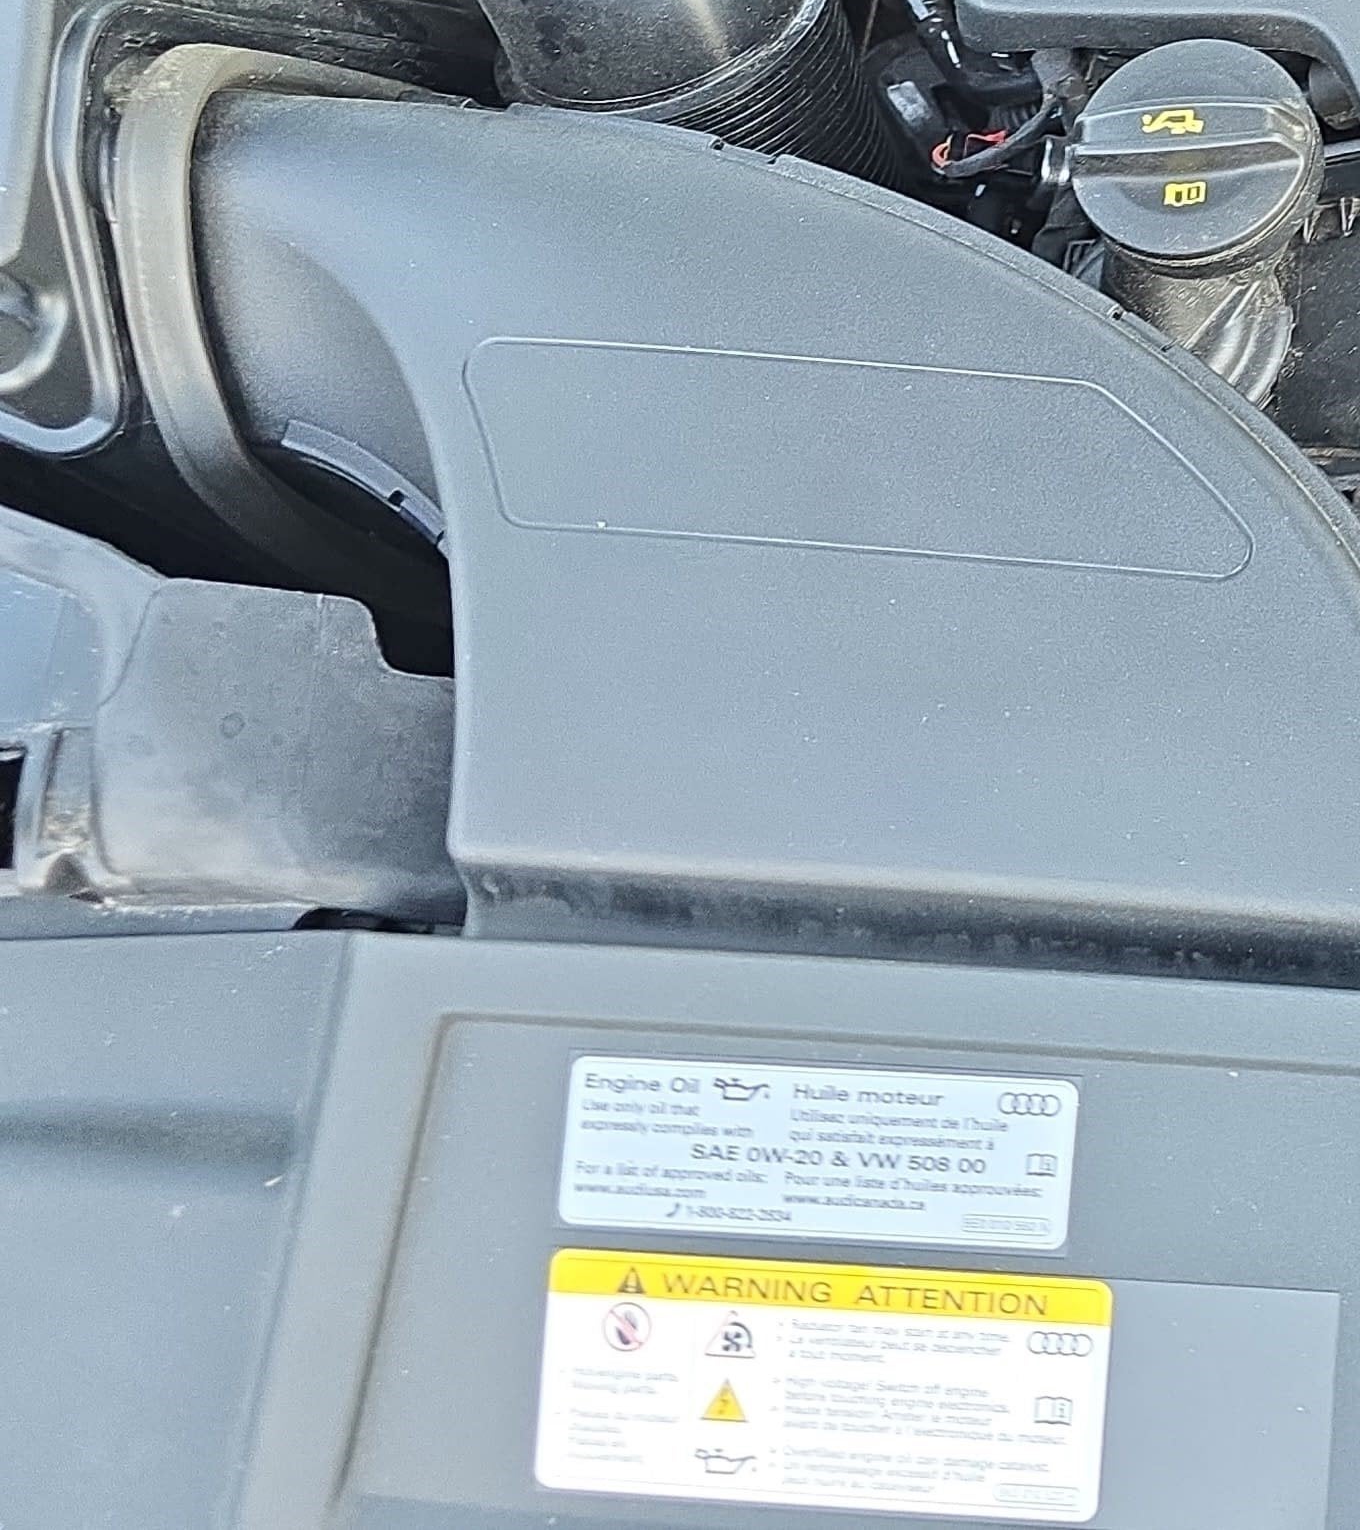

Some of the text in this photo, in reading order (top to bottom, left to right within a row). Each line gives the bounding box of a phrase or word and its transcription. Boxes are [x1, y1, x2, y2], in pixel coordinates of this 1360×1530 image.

[585, 1073, 700, 1094] Engine Oil
[792, 1083, 945, 1108] Huile moteur
[691, 1143, 986, 1175] SAE 0W-20 & VW 508 00
[663, 1272, 1049, 1318] WARNING ATTENTION
